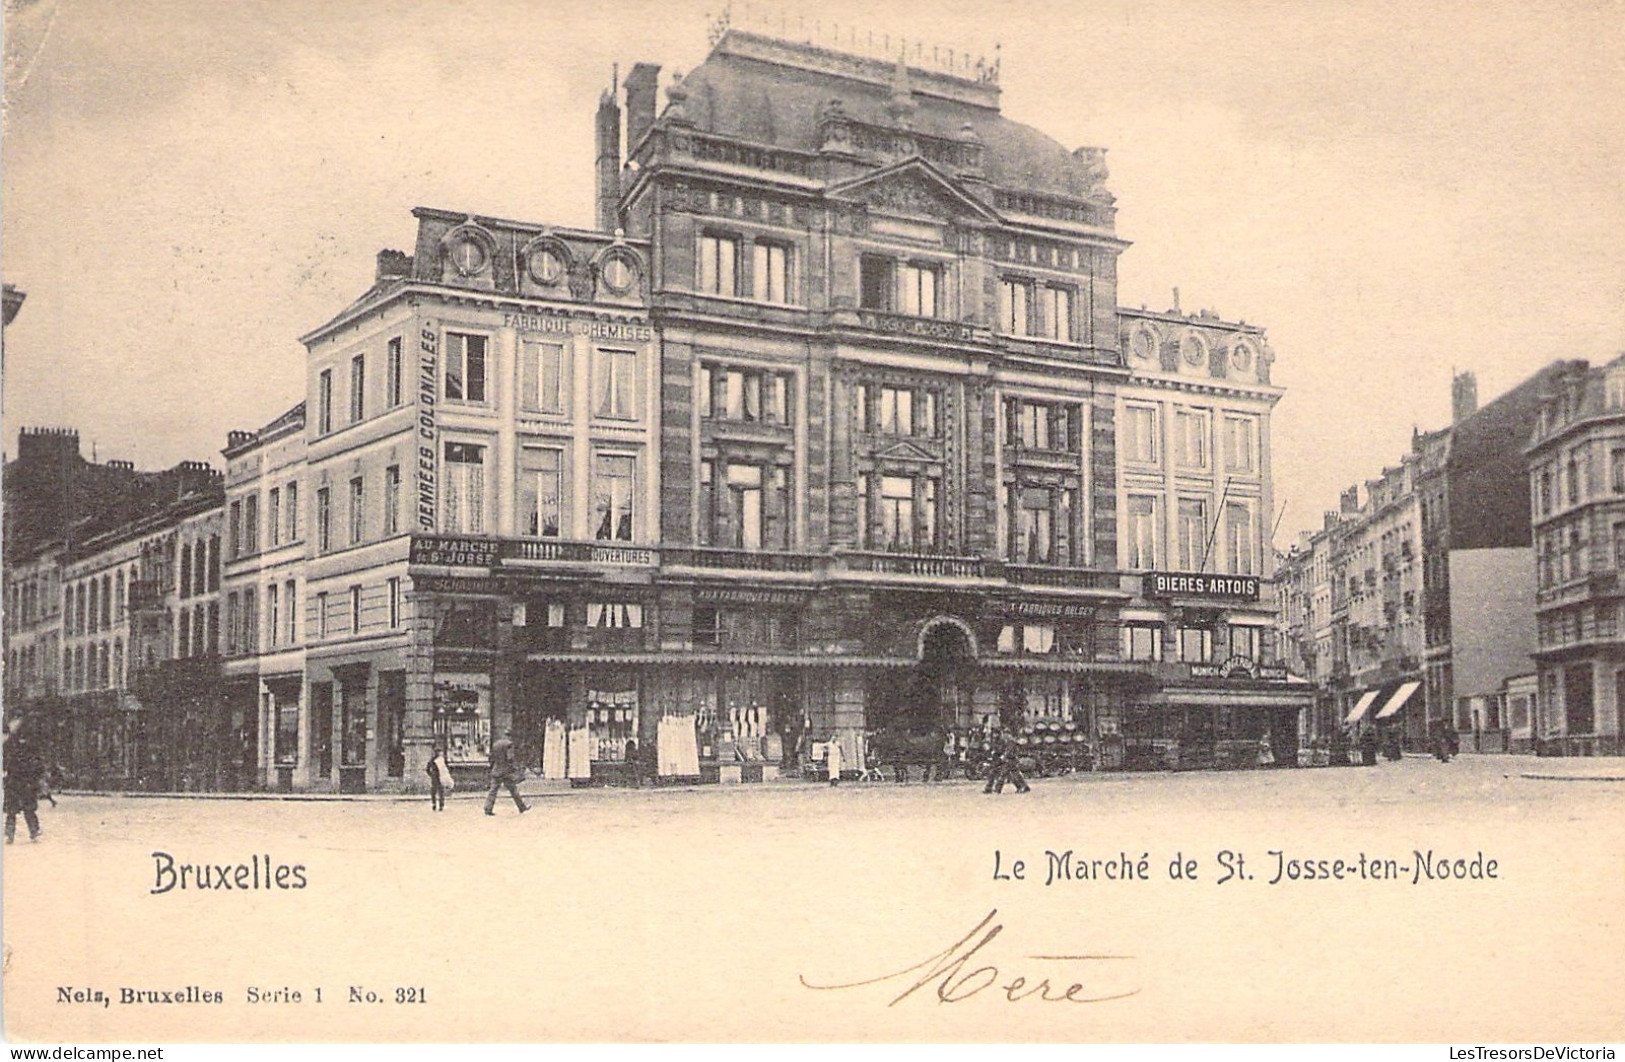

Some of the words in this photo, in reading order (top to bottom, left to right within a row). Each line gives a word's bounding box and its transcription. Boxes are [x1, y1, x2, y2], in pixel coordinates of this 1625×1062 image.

[504, 314, 572, 333] FABRIQUE
[582, 323, 651, 341] CHEMISES
[419, 329, 436, 440] COLONIALES
[415, 540, 433, 549] AU
[439, 541, 498, 553] MARCHE
[1018, 603, 1062, 616] FABRIQUES
[150, 851, 307, 895] Bruxelles
[993, 850, 1026, 881] Le
[1044, 850, 1150, 886] Marché
[1168, 852, 1199, 880] de
[1216, 850, 1254, 885] St.
[1267, 850, 1499, 885] Josse-ten-Noode
[118, 986, 224, 1004] Bruxelles
[247, 986, 302, 1004] Serie
[314, 987, 324, 1003] 1
[348, 987, 385, 1004] No.
[394, 987, 428, 1004] 321
